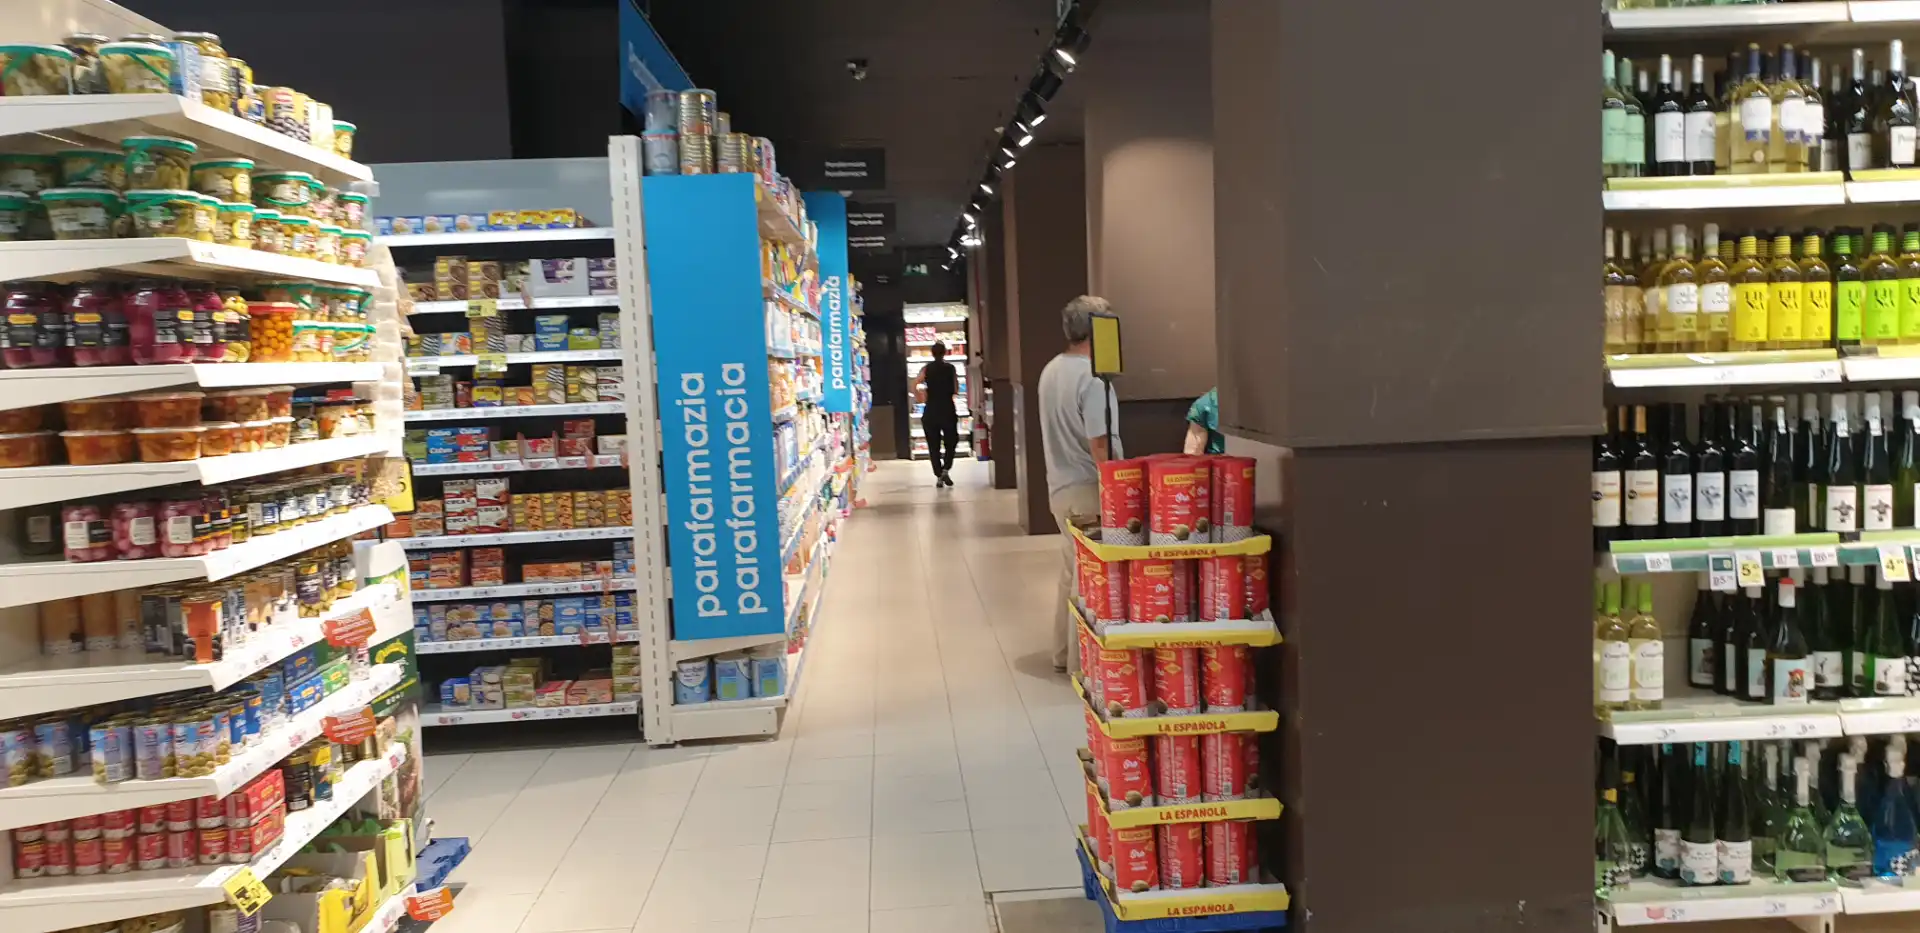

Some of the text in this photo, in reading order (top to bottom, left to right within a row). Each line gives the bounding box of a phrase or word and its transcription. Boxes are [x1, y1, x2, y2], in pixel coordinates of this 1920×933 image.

[716, 362, 769, 615] parafarmacia
[675, 372, 729, 618] parafarmazia
[1741, 563, 1751, 576] 5
[1158, 720, 1227, 732] LA ESPAÑOLA
[1160, 810, 1173, 820] LA
[1167, 907, 1180, 916] LA
